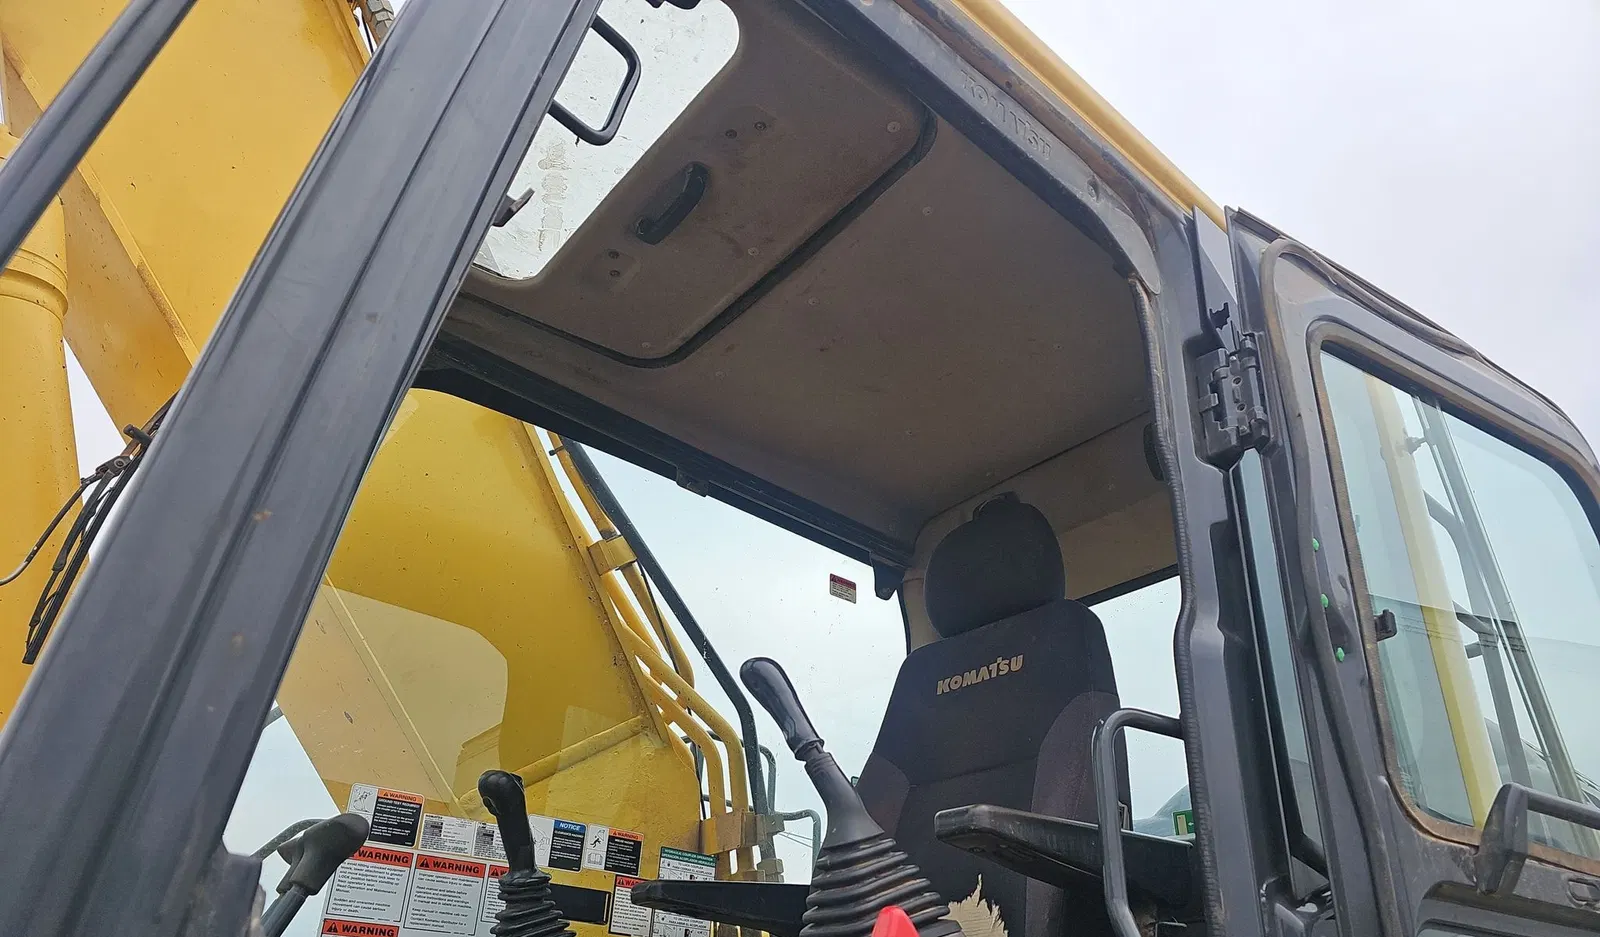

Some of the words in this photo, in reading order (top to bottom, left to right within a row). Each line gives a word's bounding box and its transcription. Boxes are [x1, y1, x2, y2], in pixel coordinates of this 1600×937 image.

[936, 654, 1024, 695] KOMATSU
[390, 793, 416, 801] WARNING
[357, 850, 409, 864] WARNING
[433, 860, 479, 874] WARNING
[342, 924, 394, 937] WARNING
